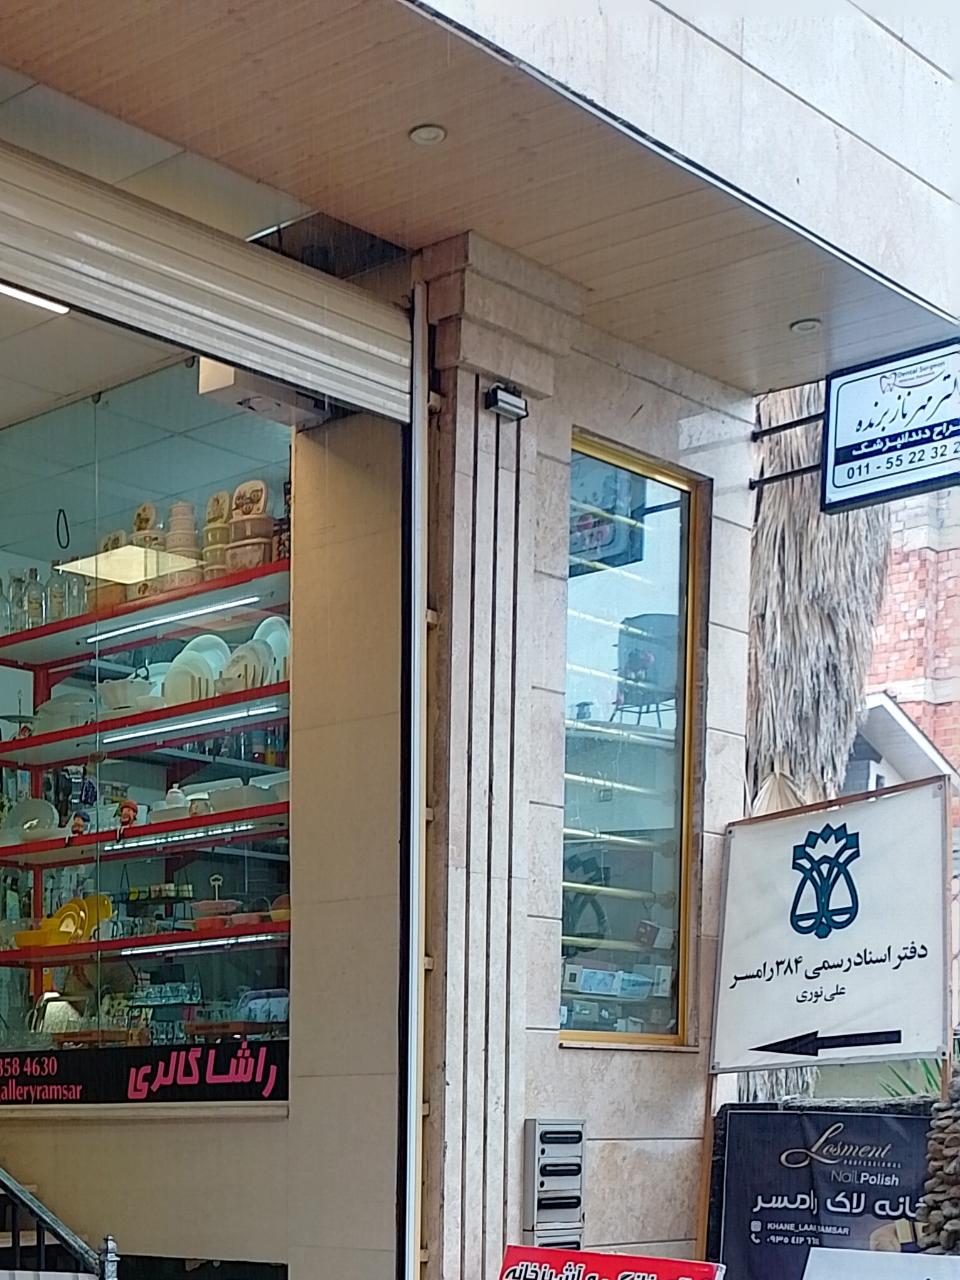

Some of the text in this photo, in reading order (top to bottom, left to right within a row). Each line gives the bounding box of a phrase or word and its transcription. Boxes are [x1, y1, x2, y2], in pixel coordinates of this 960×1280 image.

[847, 462, 870, 479] 011
[886, 454, 903, 470] 55
[909, 449, 925, 464] 22
[931, 444, 947, 459] 32
[854, 945, 892, 967] اسناد
[892, 941, 928, 969] دفتر
[729, 961, 774, 989] رامسر
[804, 956, 853, 980] رسمی
[796, 984, 846, 1003] علی نوری
[24, 1057, 58, 1077] 4630
[128, 1041, 278, 1100] راشا گالری
[830, 1170, 899, 1186] Nail Polish
[752, 1189, 818, 1216] رامسر
[826, 1191, 866, 1214] لاک
